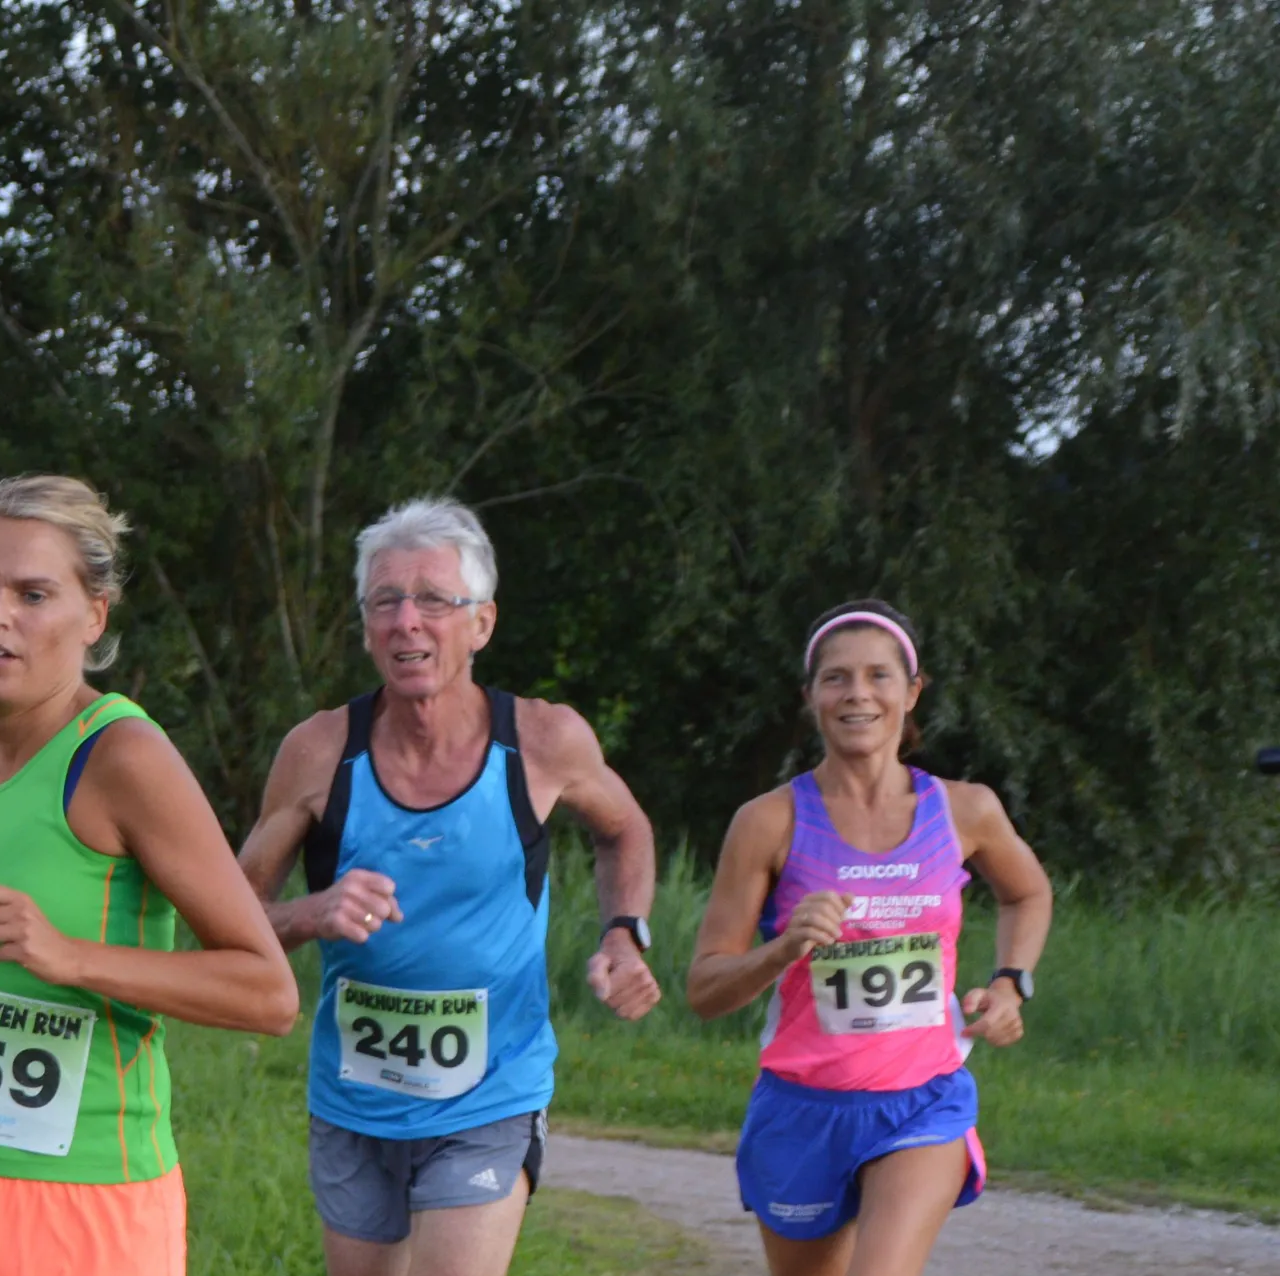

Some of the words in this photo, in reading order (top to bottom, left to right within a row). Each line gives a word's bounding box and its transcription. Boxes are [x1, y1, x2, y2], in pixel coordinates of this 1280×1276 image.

[837, 863, 920, 880] saucony
[871, 895, 941, 907] RUNNERS
[870, 907, 923, 918] WORLD
[825, 960, 937, 1010] 192
[442, 999, 477, 1015] RUN
[32, 1012, 82, 1041] RUN
[352, 1016, 469, 1069] 240
